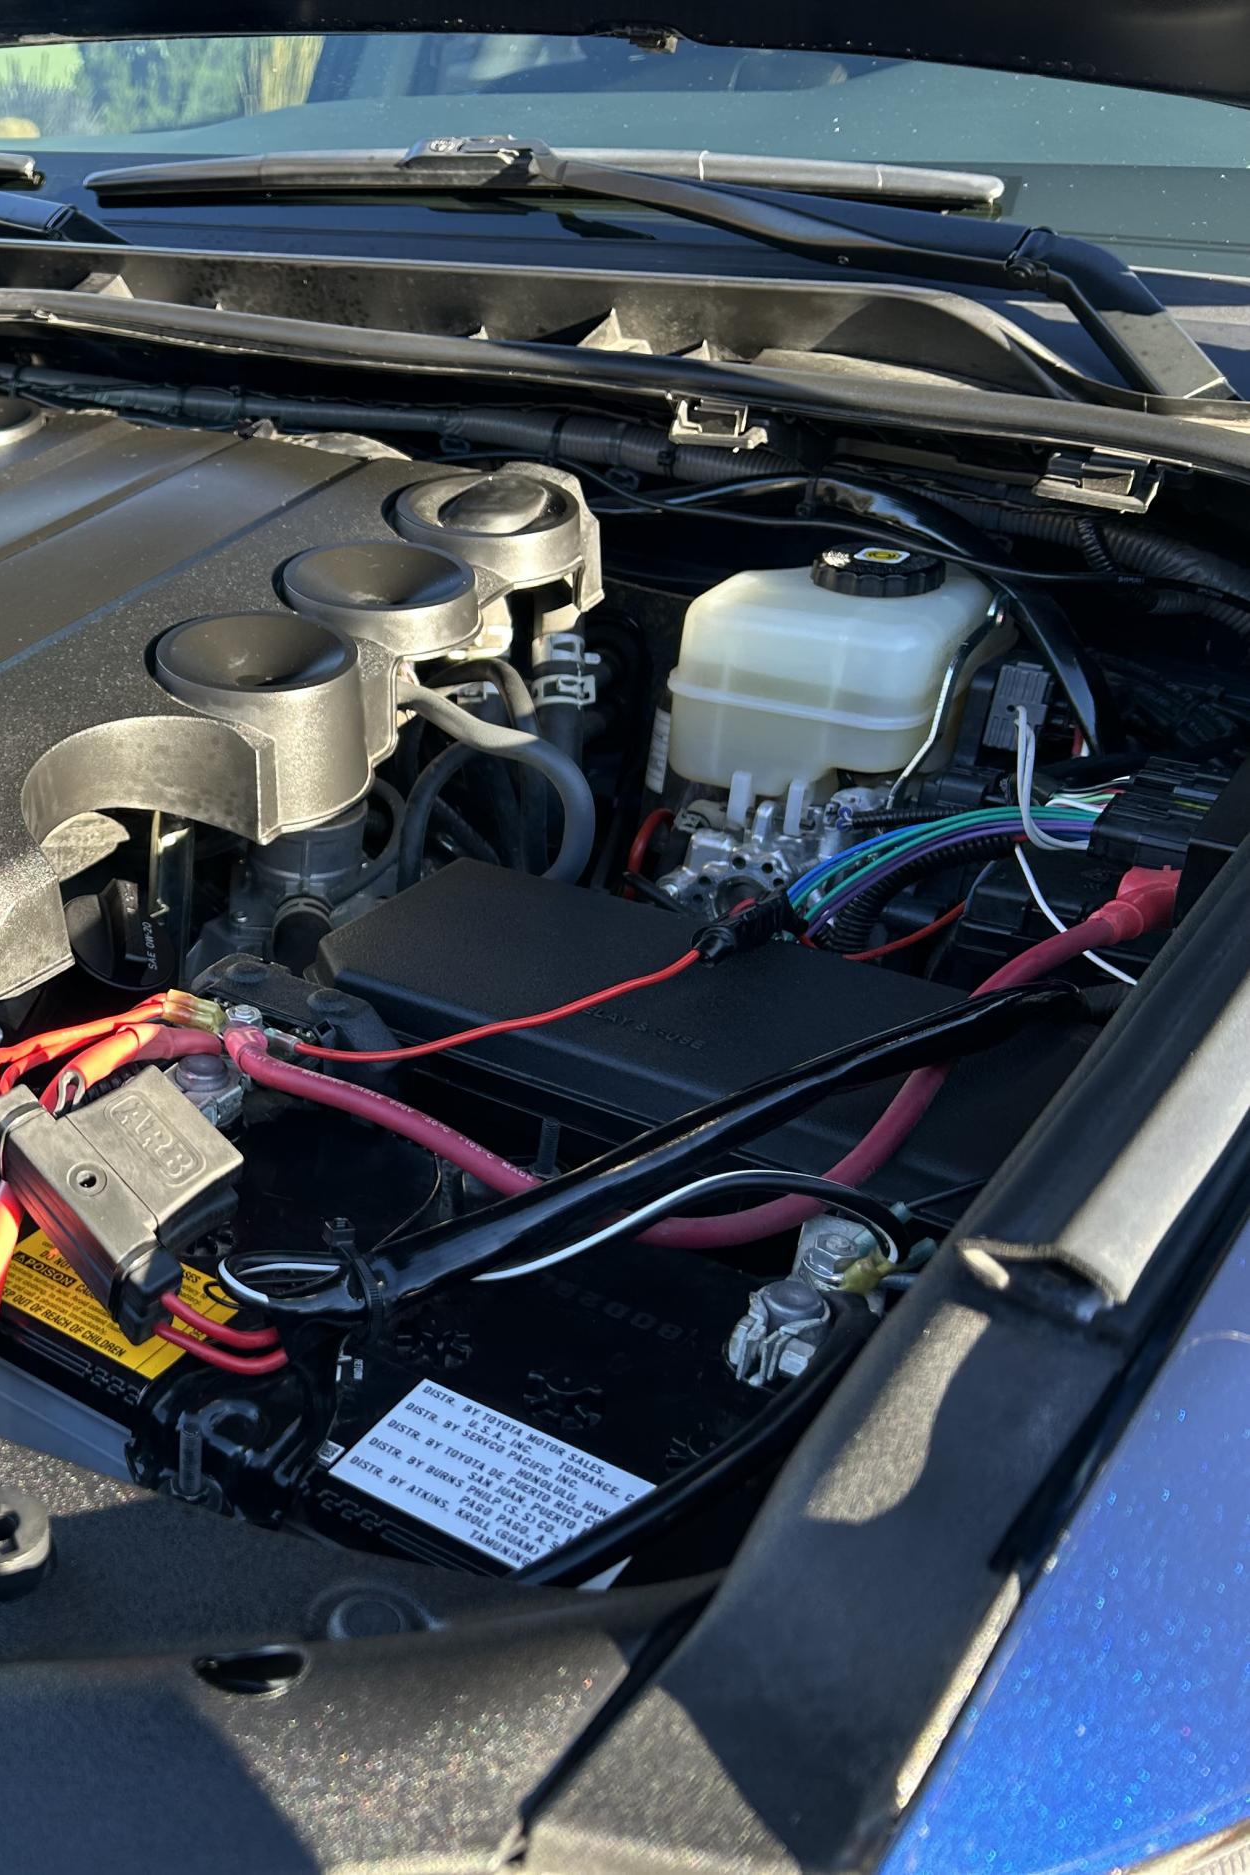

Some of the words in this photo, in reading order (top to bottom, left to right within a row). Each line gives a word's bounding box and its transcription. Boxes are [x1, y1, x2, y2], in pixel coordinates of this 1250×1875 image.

[141, 922, 156, 950] 0W-20
[147, 952, 158, 971] SAE
[112, 1101, 194, 1178] ARB
[350, 1083, 384, 1100] CABLE
[501, 1161, 534, 1183] MADE
[23, 1258, 72, 1287] POISON
[12, 1294, 31, 1306] OUT
[29, 1303, 45, 1312] OF
[41, 1309, 71, 1328] REACH
[68, 1323, 85, 1333] OF
[81, 1330, 126, 1357] CHILDREN
[405, 1402, 437, 1423] DISTR.
[442, 1420, 460, 1431] BY
[461, 1429, 504, 1453] SERVCO
[507, 1450, 552, 1475] PACIFIC
[555, 1473, 577, 1489] INC.
[422, 1386, 454, 1405] DISTR.
[462, 1404, 480, 1415] BY
[482, 1413, 522, 1436] TOYOTA
[525, 1433, 565, 1456] MOTOR
[368, 1437, 401, 1458] DISTR.
[406, 1456, 424, 1467] BY
[425, 1465, 463, 1487] BURNS
[466, 1485, 501, 1504] PHILP
[387, 1419, 420, 1440] DISTR.
[425, 1438, 442, 1449] BY
[444, 1446, 485, 1470] TOYOTA
[487, 1467, 505, 1480] DE
[506, 1477, 550, 1502] PUERTO
[553, 1500, 582, 1518] RICO
[468, 1472, 492, 1487] SAN
[530, 1502, 576, 1529] PUERTO
[349, 1456, 382, 1477] DISTR.
[388, 1475, 405, 1486] BY
[455, 1508, 489, 1530] KROLL
[495, 1529, 539, 1554] (GUAM)
[459, 1496, 492, 1515] PAGO
